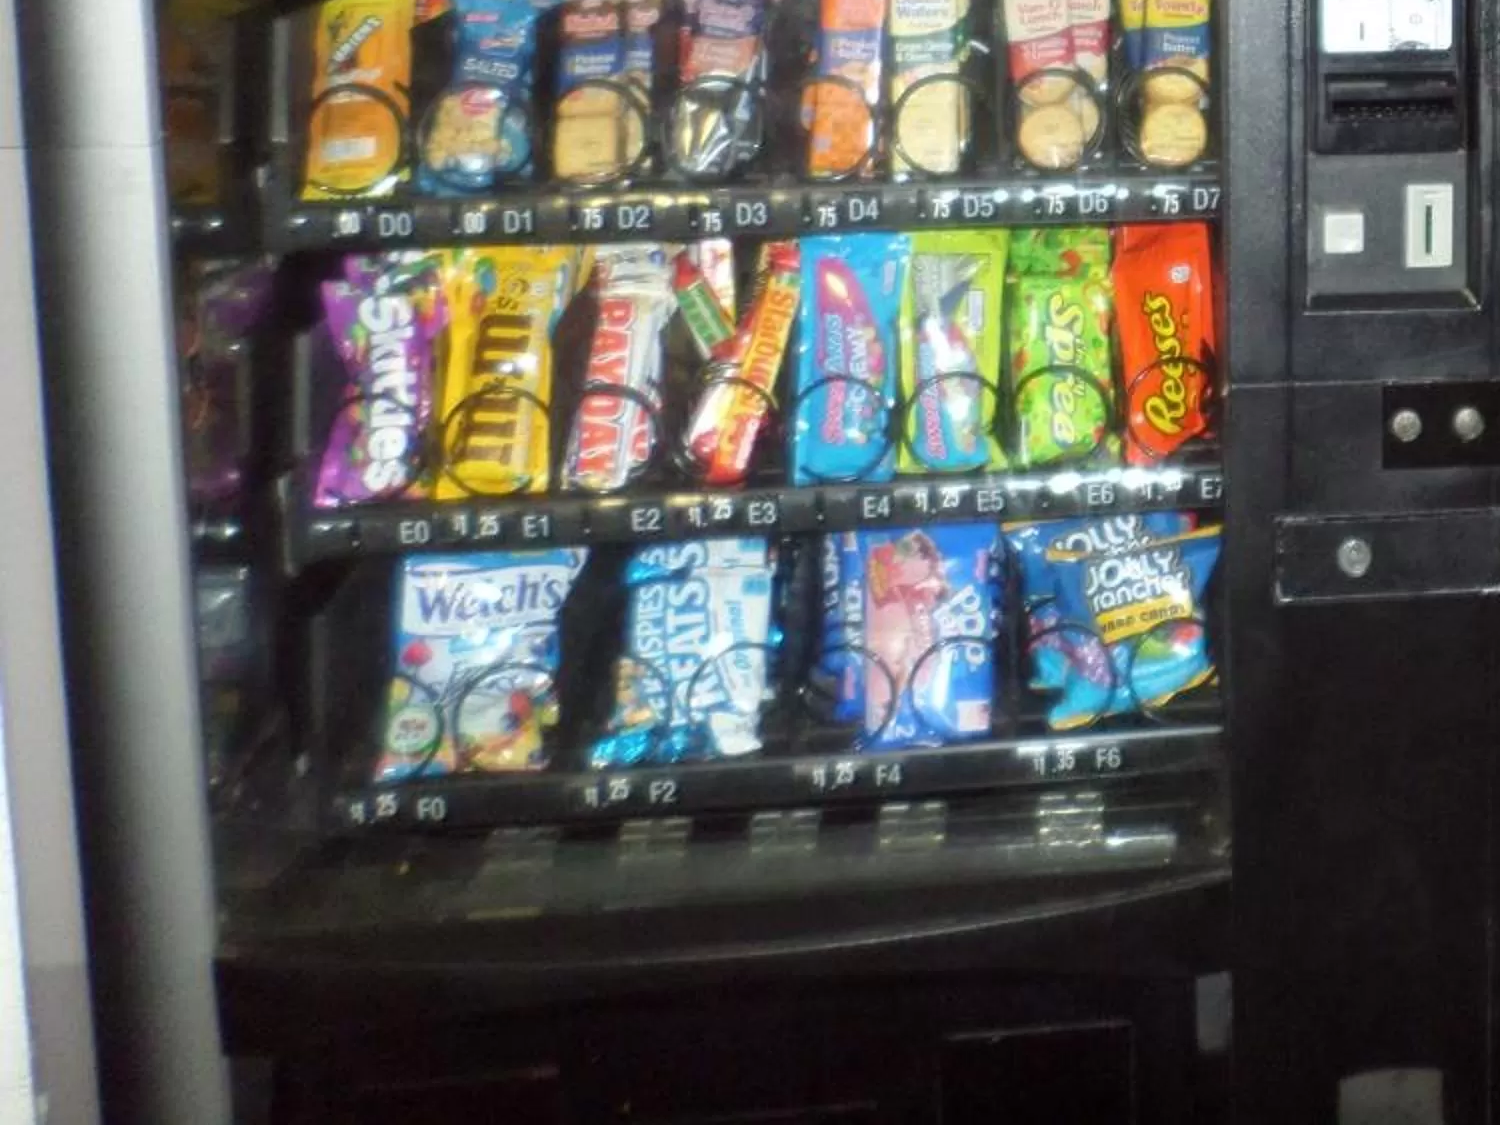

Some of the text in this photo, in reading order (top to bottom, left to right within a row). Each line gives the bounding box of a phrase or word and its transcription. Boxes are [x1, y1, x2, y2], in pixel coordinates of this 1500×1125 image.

[848, 198, 880, 221] D4
[963, 194, 995, 218] D5
[1079, 192, 1110, 213] D6
[1193, 188, 1221, 211] D7
[378, 212, 412, 238] D0
[503, 210, 533, 234] D1
[617, 206, 649, 229] D2
[735, 202, 768, 225] D3
[1143, 291, 1187, 435] Reese's
[575, 299, 634, 473] PAYDAY
[977, 489, 1004, 512] E5
[1086, 482, 1115, 504] E6
[747, 502, 777, 525] E3
[863, 495, 891, 519] E4
[400, 520, 430, 544] E0
[522, 514, 550, 538] E1
[631, 508, 664, 532] E2
[1087, 550, 1178, 595] JOLLY
[1096, 749, 1121, 769] F6
[876, 764, 902, 787] F4
[649, 780, 676, 804] F2
[417, 795, 446, 820] F0
